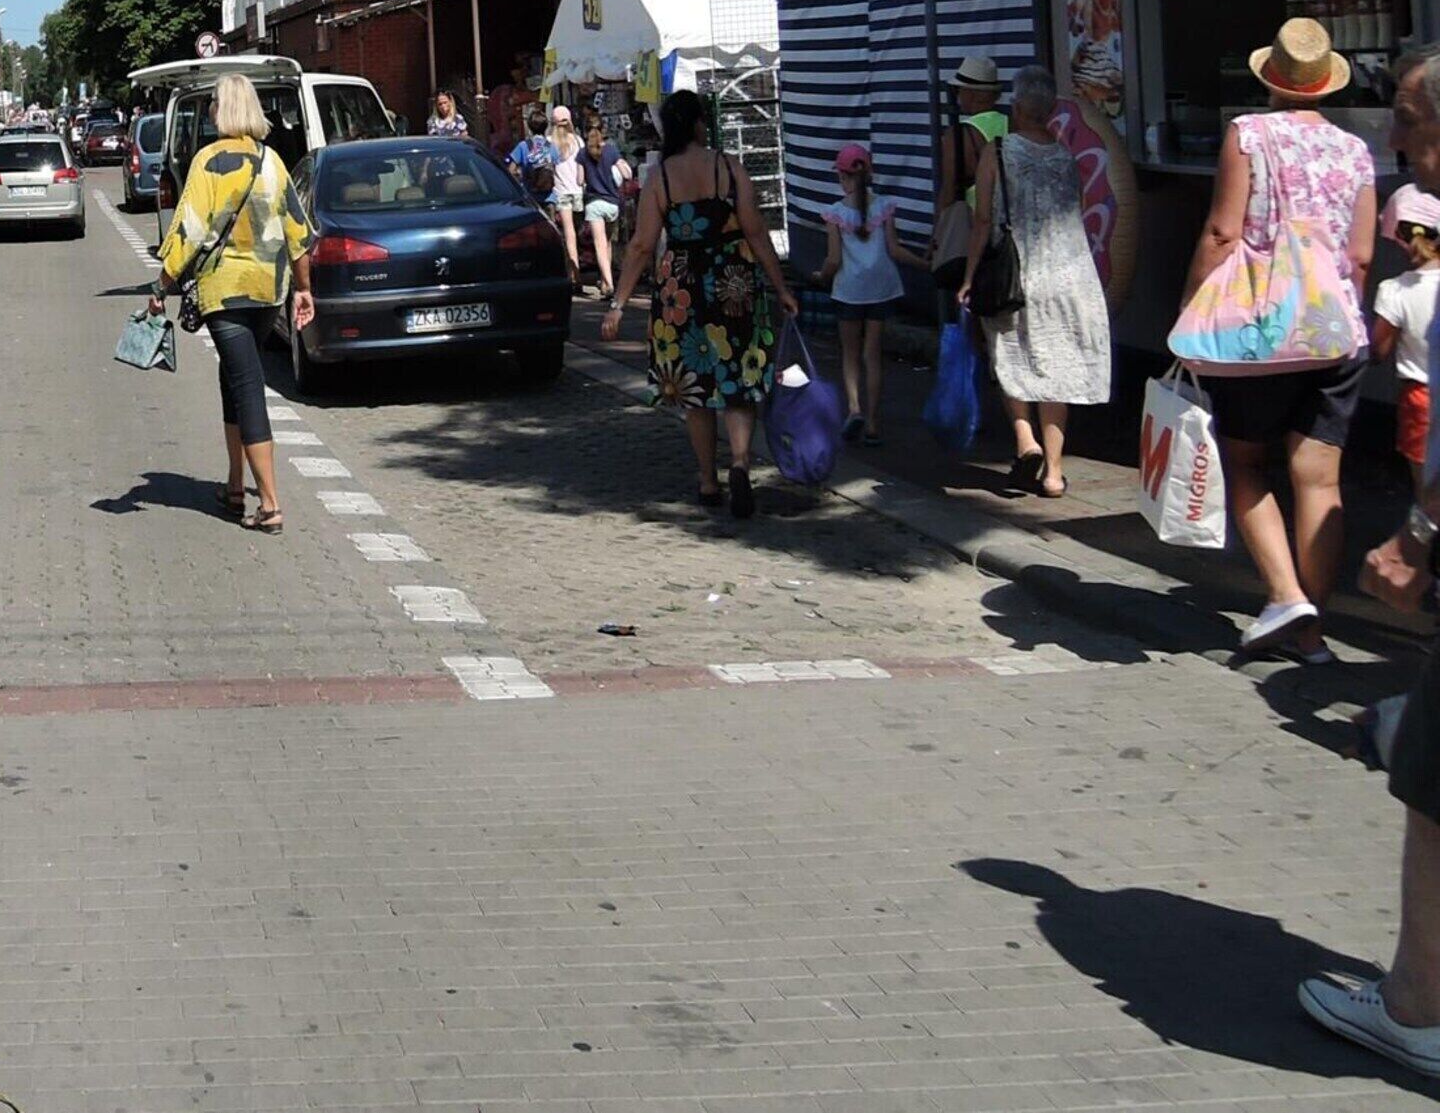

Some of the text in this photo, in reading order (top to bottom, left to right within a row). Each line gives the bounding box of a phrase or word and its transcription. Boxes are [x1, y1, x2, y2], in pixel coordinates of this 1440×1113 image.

[413, 302, 489, 326] ZKA 02356
[1186, 442, 1210, 522] MIGROS
